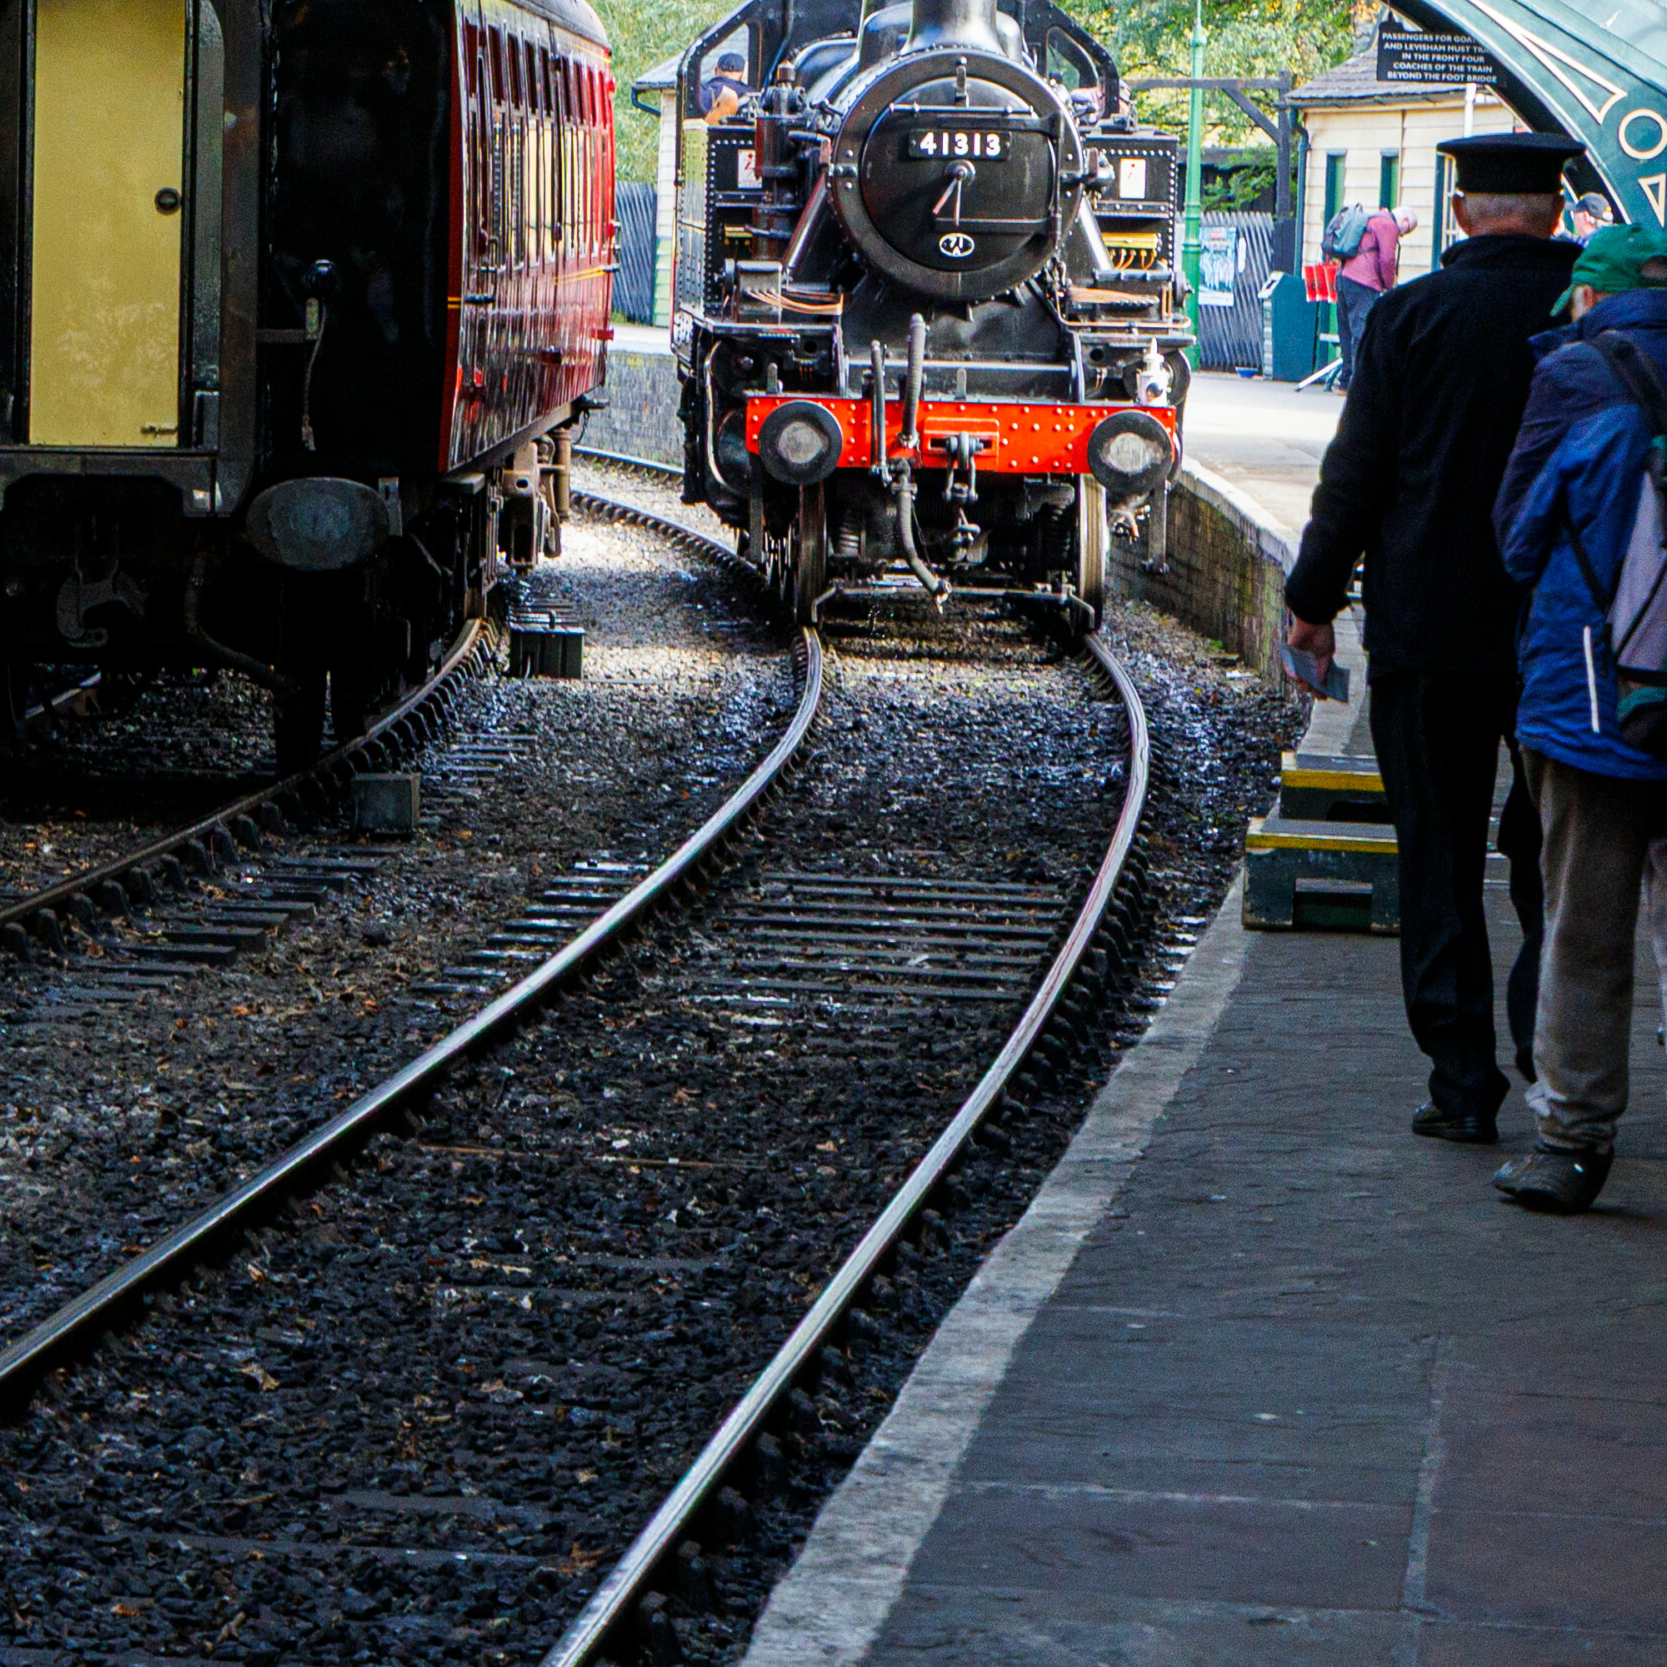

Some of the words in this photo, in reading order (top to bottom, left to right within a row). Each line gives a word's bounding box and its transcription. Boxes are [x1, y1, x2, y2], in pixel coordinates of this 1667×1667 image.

[1381, 32, 1435, 43] PASSENGERS
[1435, 33, 1453, 43] FOR
[1383, 42, 1403, 52] AND
[1404, 42, 1446, 54] LEVISHAM
[1447, 45, 1470, 55] MUST
[1401, 52, 1413, 62] IN
[1413, 52, 1430, 62] THE
[1431, 53, 1460, 64] FRONT
[1461, 54, 1485, 64] FOUR
[1393, 61, 1433, 71] COACHES
[1434, 63, 1447, 72] OF
[1448, 63, 1465, 73] THE
[1467, 64, 1493, 74] TRAIN
[1387, 71, 1423, 81] BEYOND
[1423, 71, 1441, 82] THE
[1441, 72, 1466, 83] FOOT
[1466, 74, 1498, 84] BRIDGE
[919, 130, 1002, 158] 41313
